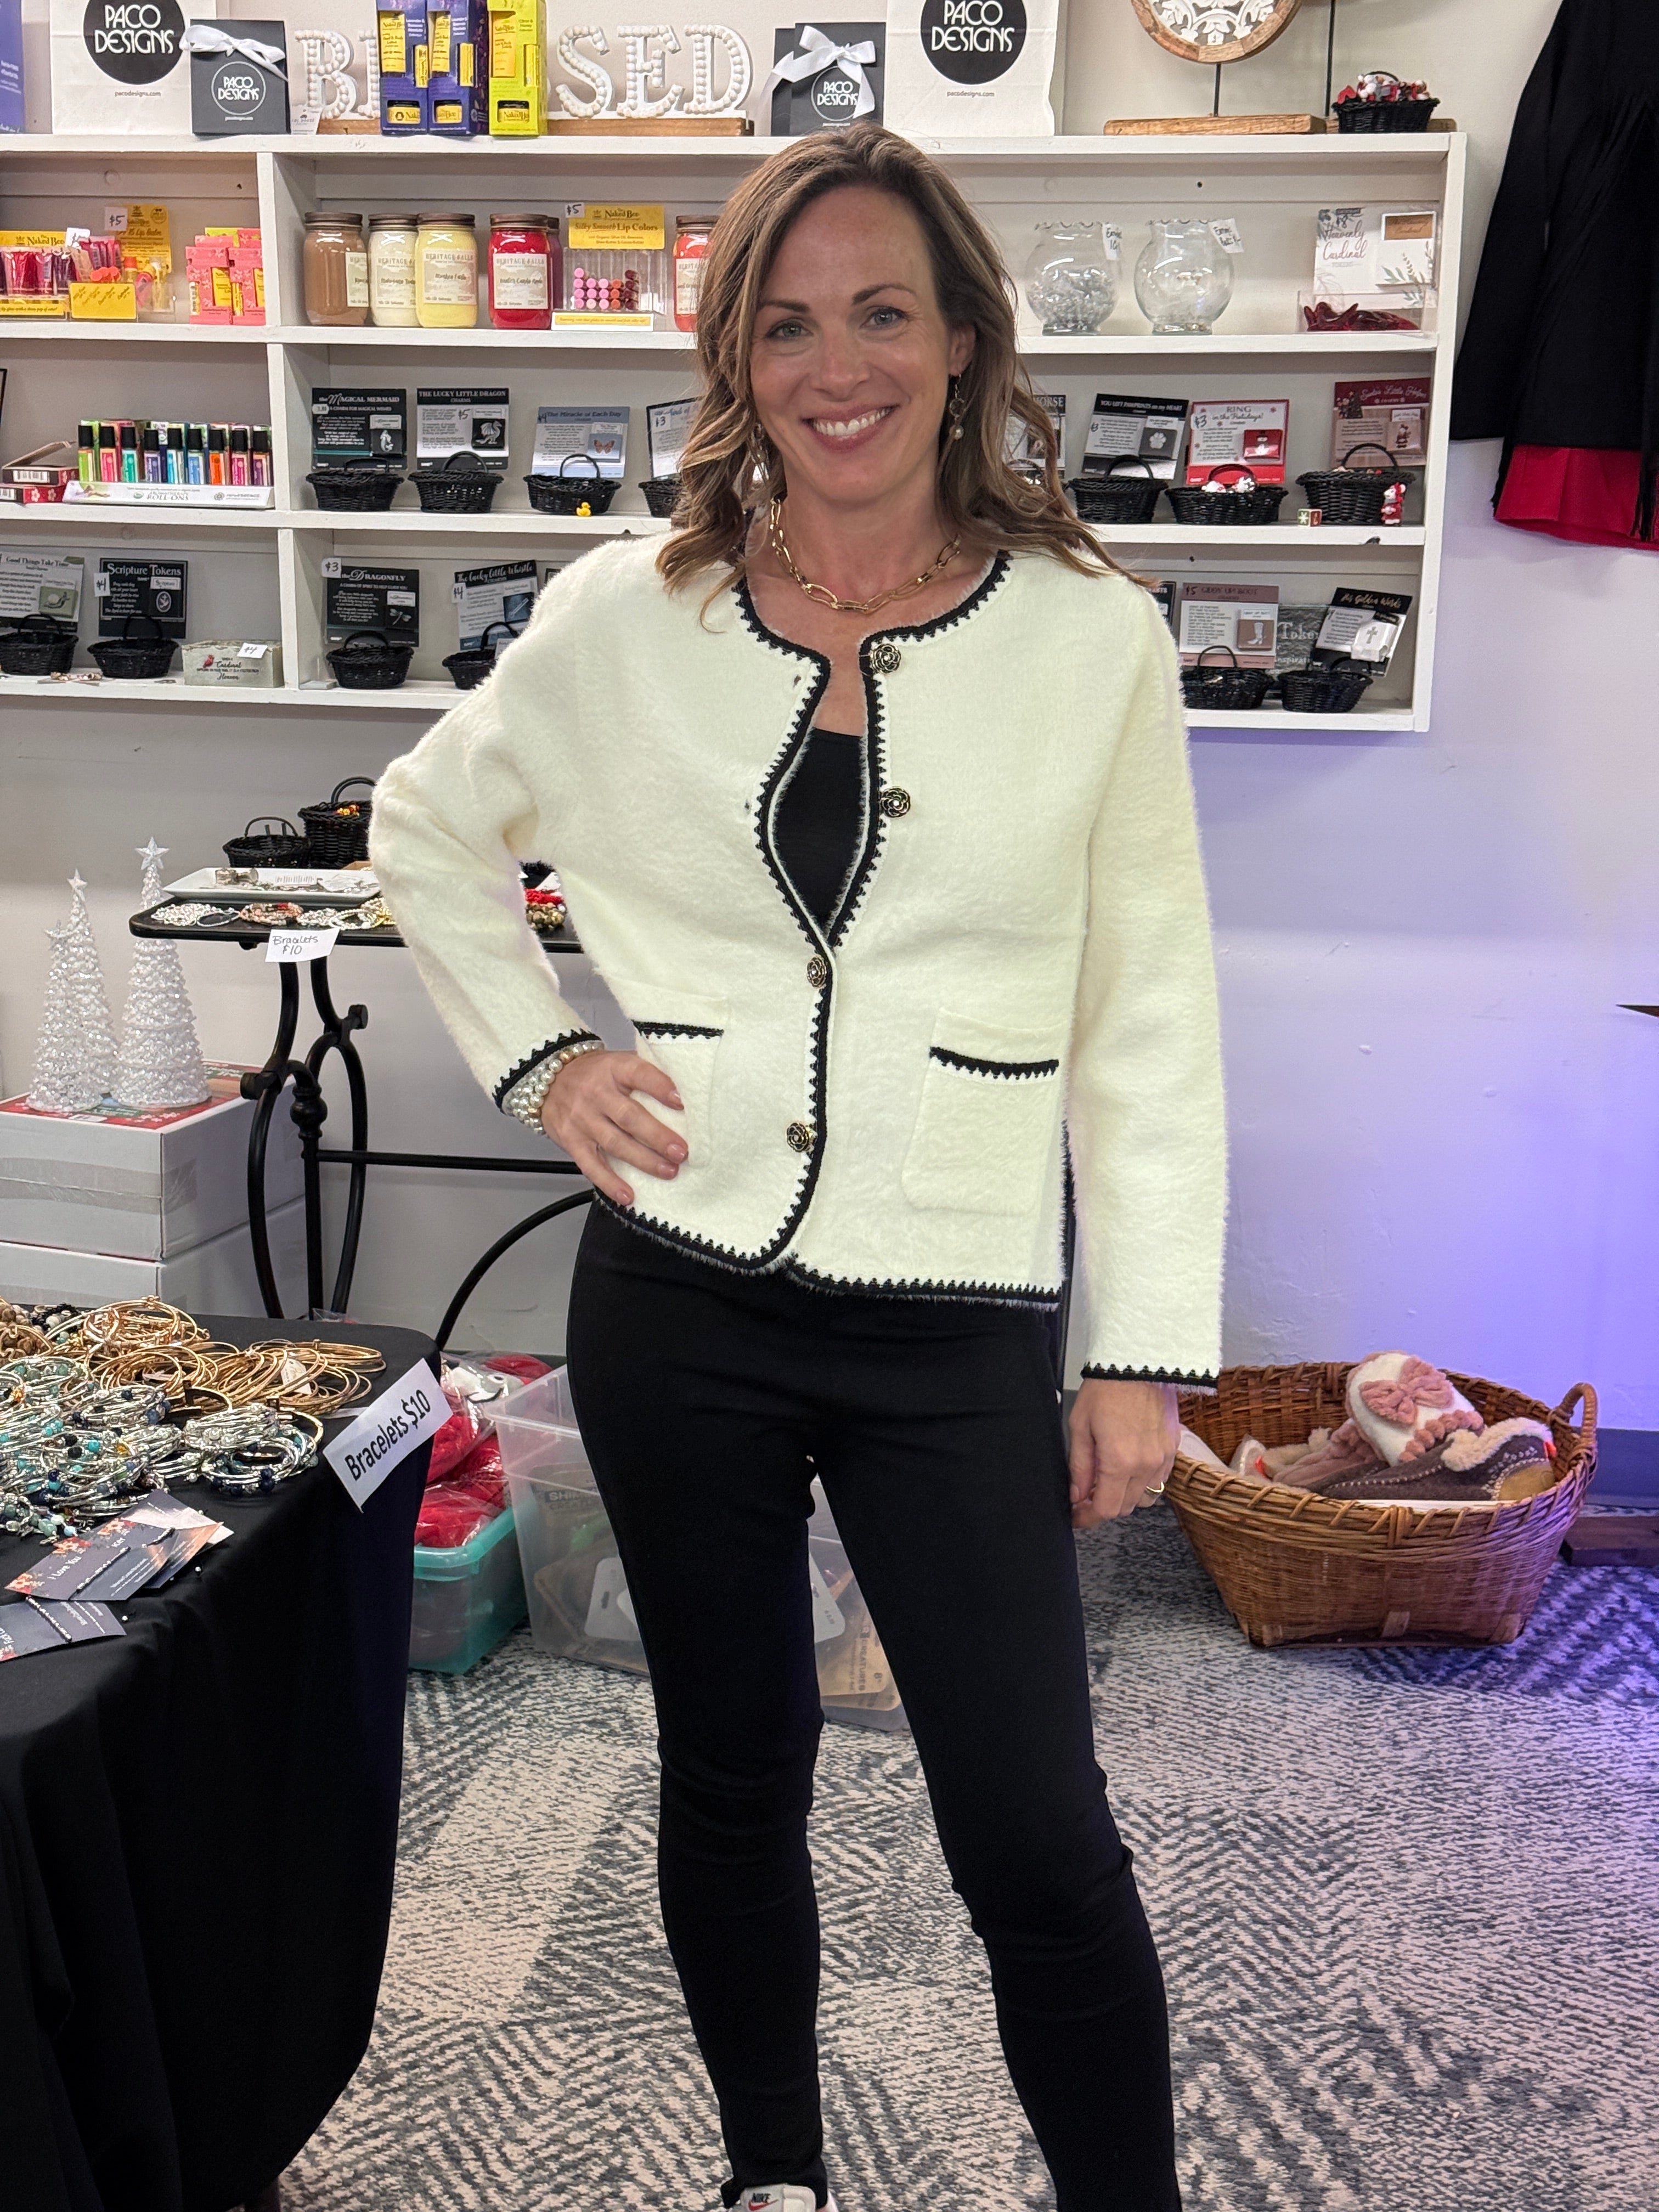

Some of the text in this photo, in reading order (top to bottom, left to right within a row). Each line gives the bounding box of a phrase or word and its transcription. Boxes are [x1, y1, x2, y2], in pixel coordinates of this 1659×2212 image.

[104, 4, 161, 30] PACO
[944, 0, 1004, 26] PACO
[94, 30, 175, 54] DESIGNS
[932, 26, 1015, 53] DESIGNS
[223, 76, 253, 88] PACO
[823, 81, 853, 93] PACO
[217, 88, 260, 100] DESIGNS
[816, 93, 859, 106] DESIGNS
[567, 204, 582, 216] $5
[605, 210, 640, 218] Naked Bee
[109, 214, 126, 227] $5
[574, 222, 658, 233] Silky Smooth Lip Colors
[27, 236, 65, 246] Naked Bee
[1325, 219, 1365, 251] Heavenly
[1323, 240, 1368, 261] Cardinal
[432, 390, 455, 398] LUCKY
[1404, 385, 1427, 399] Helper
[328, 392, 366, 406] MAGICAL
[458, 408, 471, 421] $5
[1194, 414, 1207, 428] $3
[22, 557, 41, 566] Things
[325, 561, 340, 572] $3
[106, 563, 182, 576] Scripture Tokens
[349, 569, 406, 582] DRAGONFLY
[457, 573, 469, 583] The
[507, 562, 533, 576] Whistle
[96, 577, 106, 592] $4
[1185, 586, 1199, 596] $5
[453, 586, 464, 600] $4
[272, 935, 319, 945] Bracelets
[282, 944, 302, 955] $10
[345, 1389, 431, 1481] Bracelets $10
[51, 1565, 70, 1578] Love
[65, 1555, 82, 1565] You
